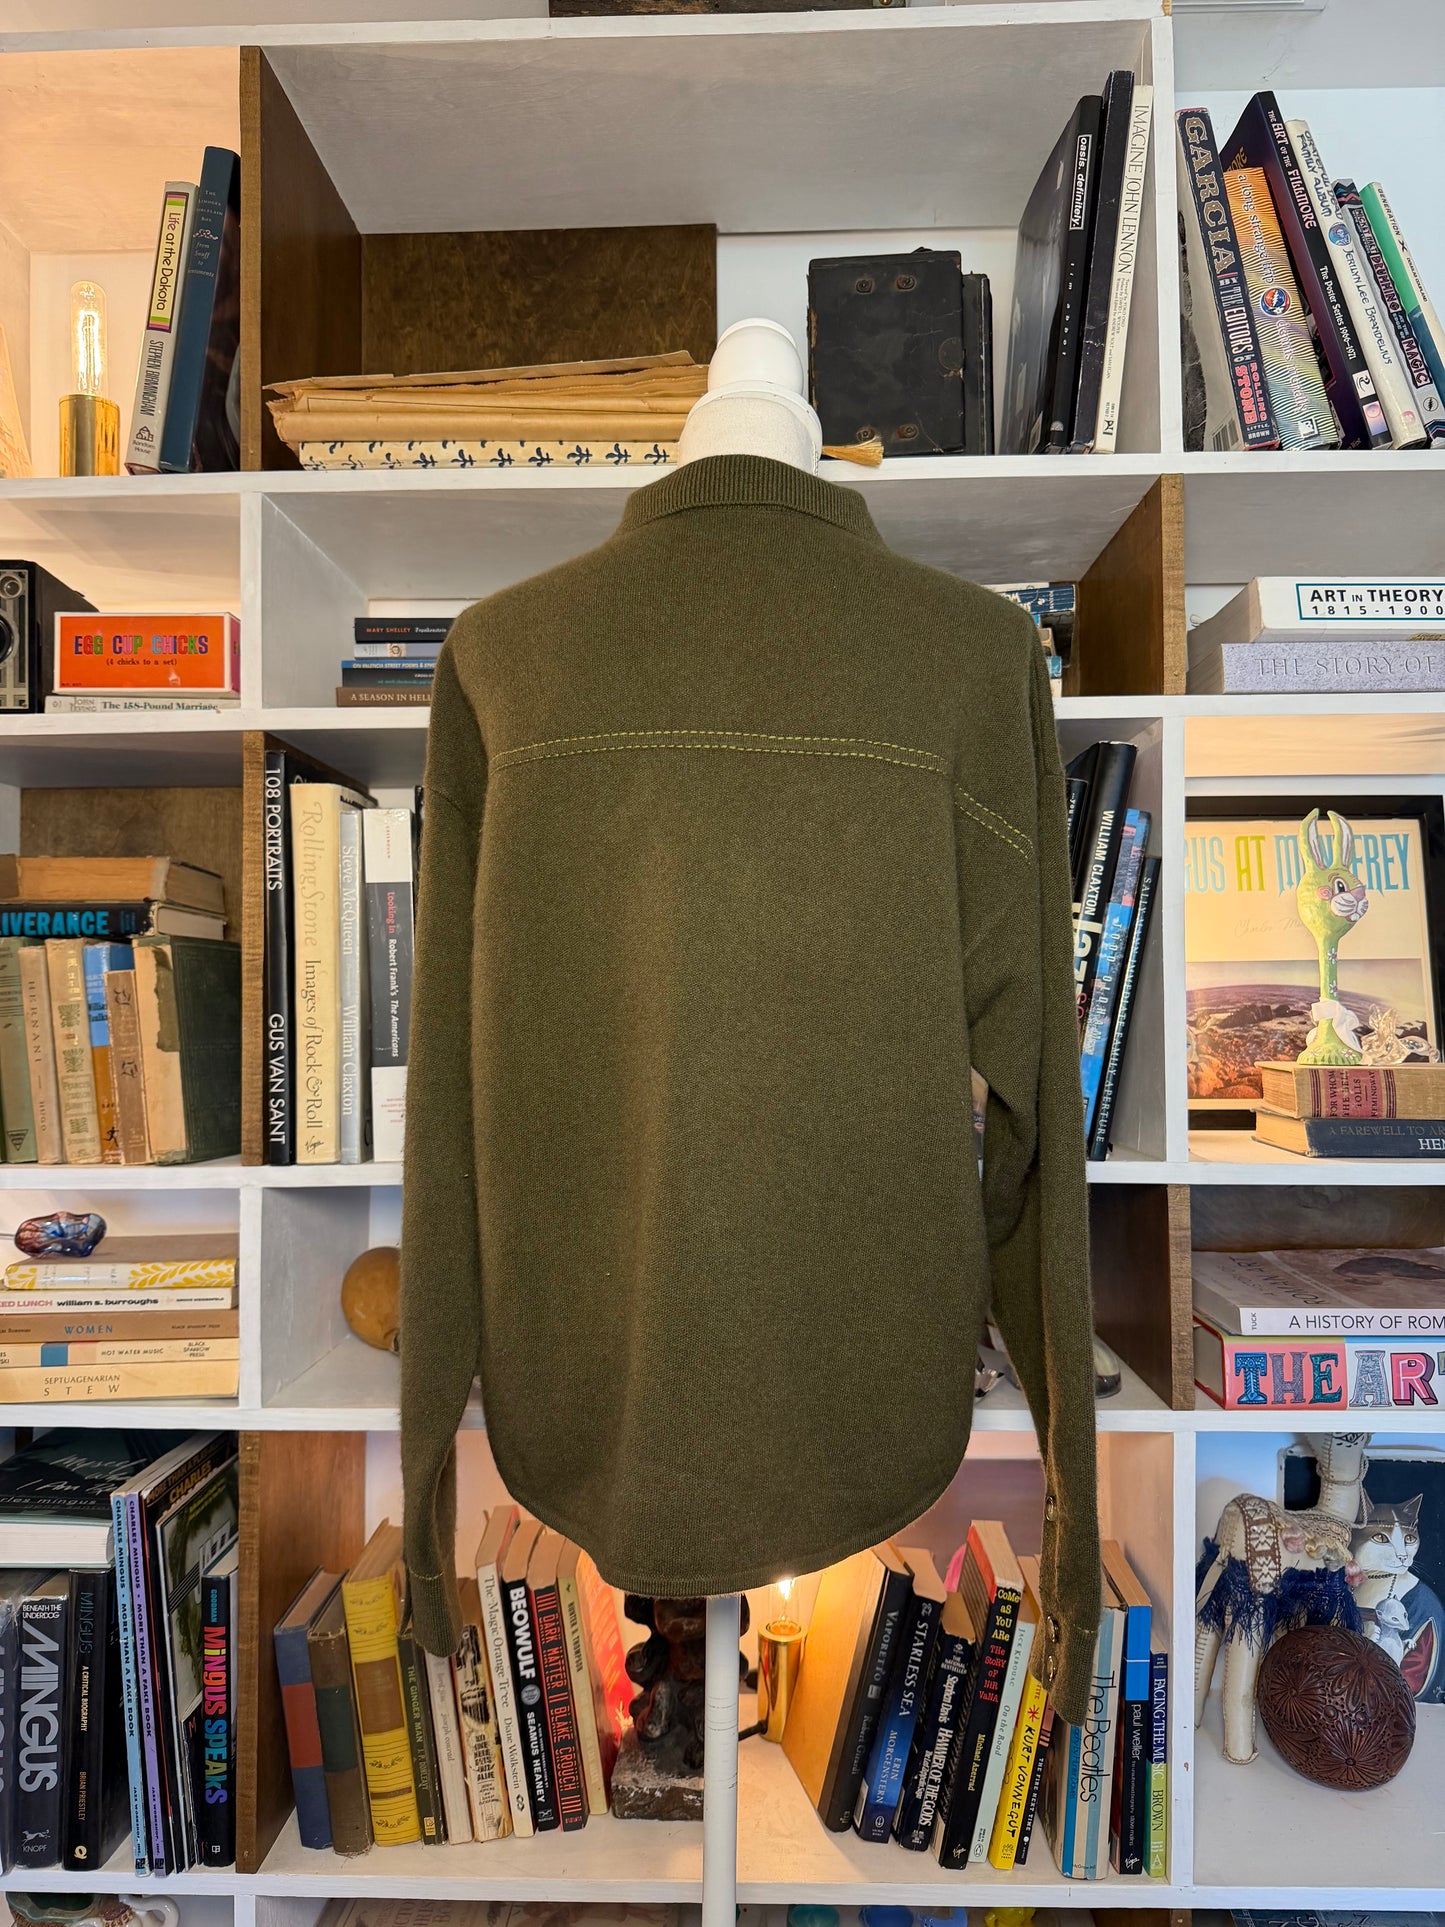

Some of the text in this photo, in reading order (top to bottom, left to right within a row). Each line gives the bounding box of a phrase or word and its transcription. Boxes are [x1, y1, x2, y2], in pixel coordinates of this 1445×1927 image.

[1128, 105, 1149, 173] IMAGINE
[1071, 137, 1087, 228] oasis. definitely.
[1267, 110, 1317, 229] THE ART FILLMORE
[1297, 134, 1332, 217] FAMILY ALBUM
[1124, 175, 1142, 214] JOHN
[1185, 116, 1236, 275] GARCIA
[1242, 184, 1275, 284] long strange trip
[1377, 188, 1408, 252] GENERATION X
[156, 212, 181, 311] Life at the Dakota
[1117, 217, 1138, 275] LENNON
[1319, 265, 1345, 327] The Poster Series
[1370, 255, 1401, 312] DRUMMING
[1220, 286, 1254, 355] THE EDITORS
[1276, 319, 1294, 361] dennis
[147, 339, 165, 371] STEPHEN
[1402, 338, 1431, 387] MAGIC
[1234, 364, 1258, 425] STONE
[1250, 362, 1268, 422] ROLLING
[1310, 589, 1346, 602] ART
[1367, 589, 1444, 602] THEORY
[1312, 605, 1443, 615] 1815-1900
[74, 635, 209, 655] EGG CUP CHICKS
[117, 658, 151, 666] chicks to
[1255, 655, 1437, 676] THE STORY OF
[102, 701, 121, 710] The
[359, 694, 394, 702] SEASON
[265, 768, 283, 891] 108 PORTRAITS
[1095, 810, 1115, 861] WILLIAM
[299, 801, 326, 947] Rolling Stone
[1235, 835, 1266, 891] AT
[341, 846, 356, 955] Steve McQueen
[1084, 864, 1104, 916] CLAXTON
[0, 911, 110, 936] IVERANCE
[300, 960, 321, 1013] Images
[386, 892, 399, 1057] Looking Robert The Americans
[28, 981, 42, 1062] HERNANI
[302, 1018, 324, 1034] of
[306, 1034, 323, 1075] Rock
[342, 1004, 359, 1115] William Claxton
[1107, 1032, 1123, 1075] FAMILY
[269, 1013, 286, 1145] GUS VAN SANT
[1328, 1070, 1338, 1117] FOR WHOM
[306, 1099, 323, 1129] Roll
[1095, 1080, 1114, 1143] APERTURE
[1340, 1126, 1425, 1136] FAREWELL TO
[17, 1300, 53, 1308] LUNCH
[105, 1298, 159, 1306] burroughs
[1289, 1315, 1300, 1329] A
[1306, 1315, 1374, 1329] HISTORY
[1379, 1315, 1403, 1329] OF
[64, 1325, 113, 1335] WOMEN
[44, 1375, 120, 1384] SEPTUAGENARIAN
[44, 1384, 120, 1396] STEW
[1234, 1352, 1342, 1405] THE
[115, 1500, 123, 1543] CHARLES
[129, 1500, 138, 1544] CHARLES
[117, 1547, 126, 1589] MINGUS
[133, 1547, 141, 1589] MINGUS
[22, 1604, 49, 1612] BENEATH
[22, 1611, 60, 1619] UNDERDOG
[121, 1603, 129, 1633] MORE
[136, 1603, 144, 1633] MORE
[210, 1589, 218, 1623] GOODMAN
[541, 1613, 561, 1643] DARK
[123, 1636, 131, 1664] THAN
[509, 1586, 536, 1680] BEOWULF
[484, 1575, 520, 1789] The Magic Orange Tree Wolkstein
[546, 1646, 567, 1689] MATTER
[898, 1620, 929, 1717] STARLESS SEA
[19, 1619, 60, 1793] MINGUS
[78, 1592, 95, 1821] MINGUS BIOGRAPHY PRIESTLEY
[407, 1665, 423, 1743] THE GINGER MAN
[938, 1702, 953, 1724] Davis
[1131, 1704, 1142, 1727] paul
[1153, 1678, 1166, 1718] FACING
[127, 1707, 135, 1737] BOOK
[527, 1711, 539, 1756] SEAMUS
[553, 1706, 574, 1742] BLAKE
[995, 1704, 1011, 1757] On the Road
[1021, 1724, 1036, 1763] KURT
[1080, 1669, 1116, 1803] The Beatles
[1153, 1719, 1165, 1744] THE
[967, 1733, 986, 1792] Michael Azerrad
[1131, 1729, 1141, 1760] weller
[1152, 1745, 1165, 1780] MUSIC
[532, 1759, 546, 1803] HEANEY
[558, 1746, 578, 1792] CROUCH
[875, 1730, 898, 1804] MORGENSTERN
[891, 1757, 902, 1780] ERIN
[919, 1727, 953, 1827] HAMMER OF THE GODS
[1006, 1765, 1028, 1838] VONNEGUT
[1151, 1789, 1164, 1831] BROWN
[23, 1845, 47, 1853] KNOPF
